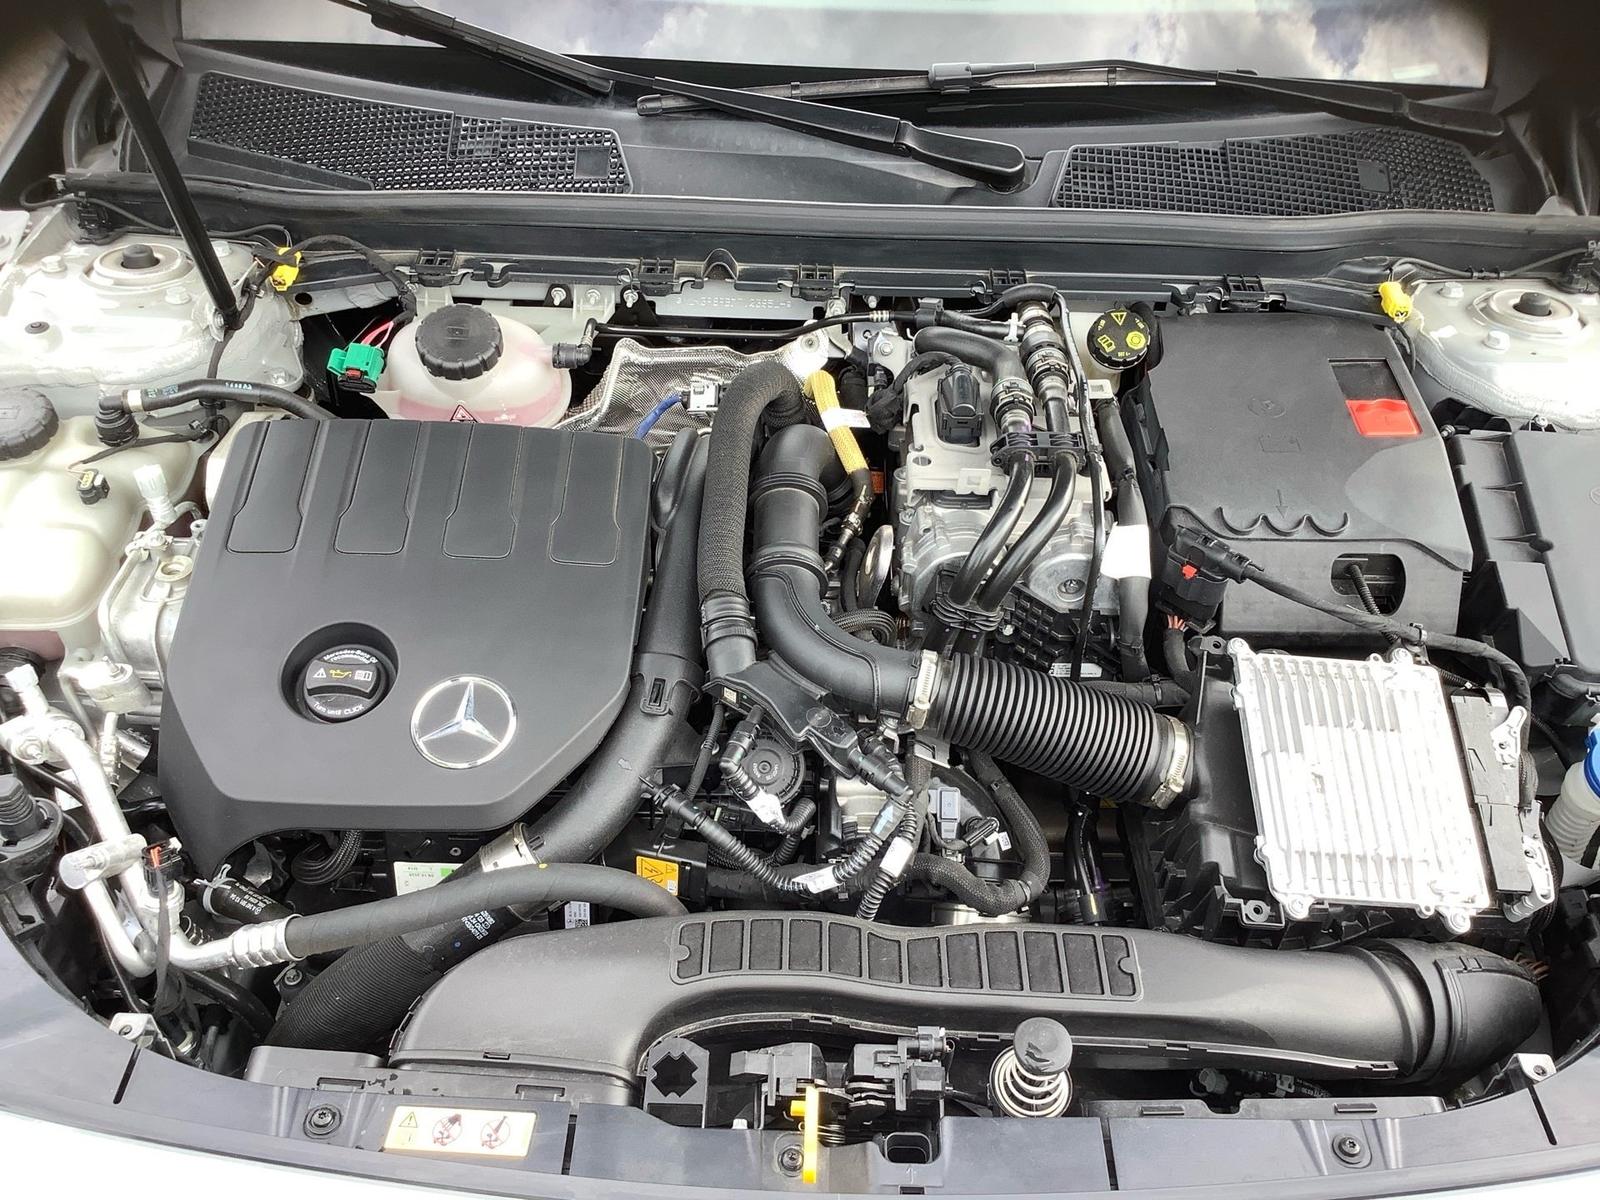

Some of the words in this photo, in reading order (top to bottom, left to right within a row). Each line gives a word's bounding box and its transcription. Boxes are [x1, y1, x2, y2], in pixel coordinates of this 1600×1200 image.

[322, 649, 370, 661] Mercedes-Benz
[313, 701, 327, 713] Turn
[343, 704, 365, 715] CLICK
